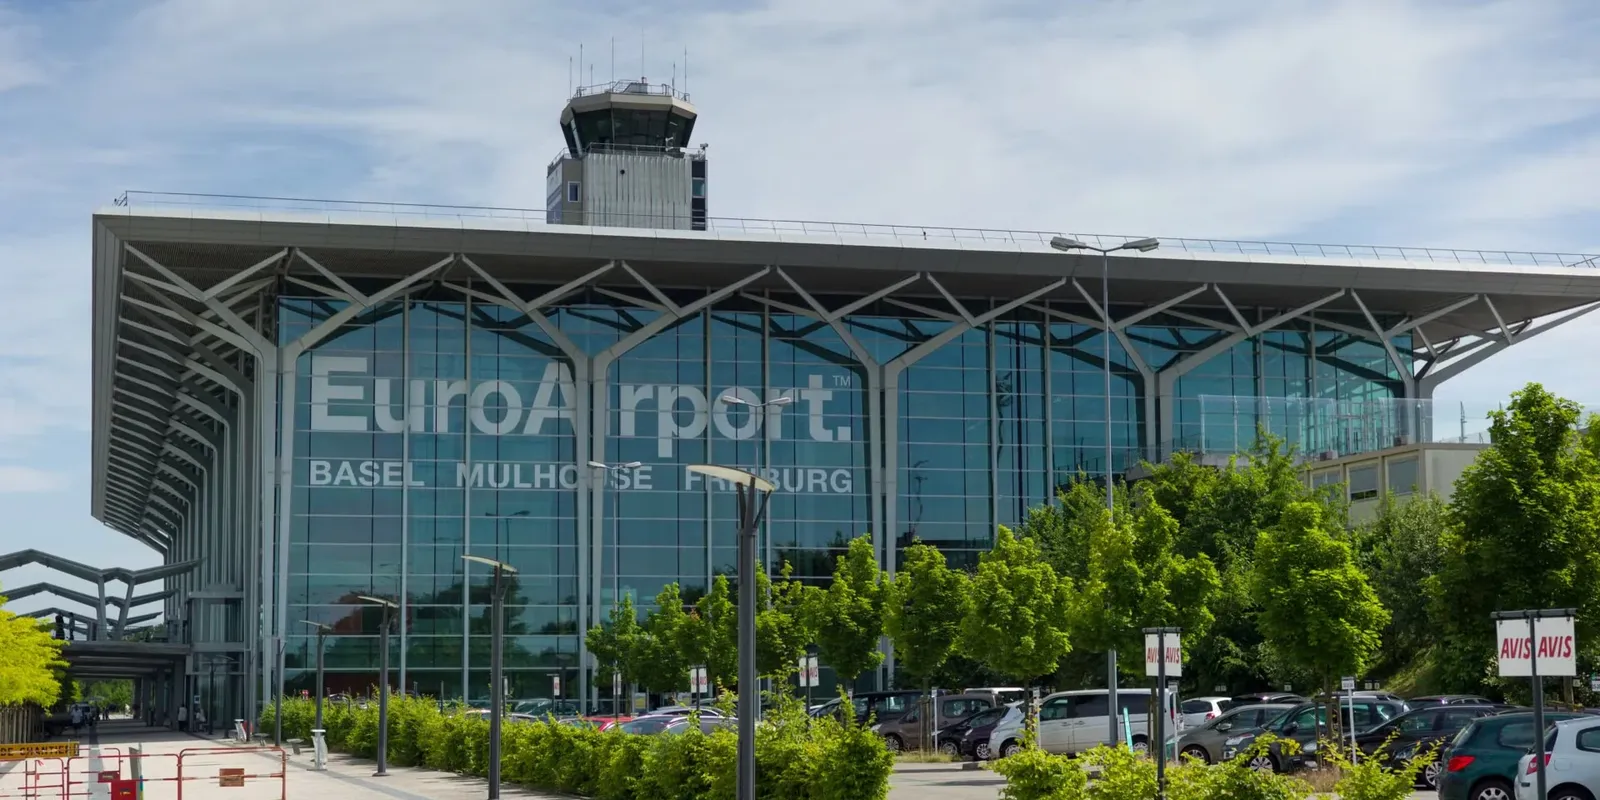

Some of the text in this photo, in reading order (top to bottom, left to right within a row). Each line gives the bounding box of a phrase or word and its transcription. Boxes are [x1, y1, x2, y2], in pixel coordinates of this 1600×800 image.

[311, 356, 852, 458] EuroArport.
[309, 460, 425, 487] BASEL
[456, 463, 653, 490] MULHOSE
[1147, 647, 1160, 664] AVI
[1166, 646, 1180, 664] AVIS
[1500, 637, 1531, 659] AVIS
[1538, 635, 1572, 658] AVIS
[1, 747, 14, 757] DE
